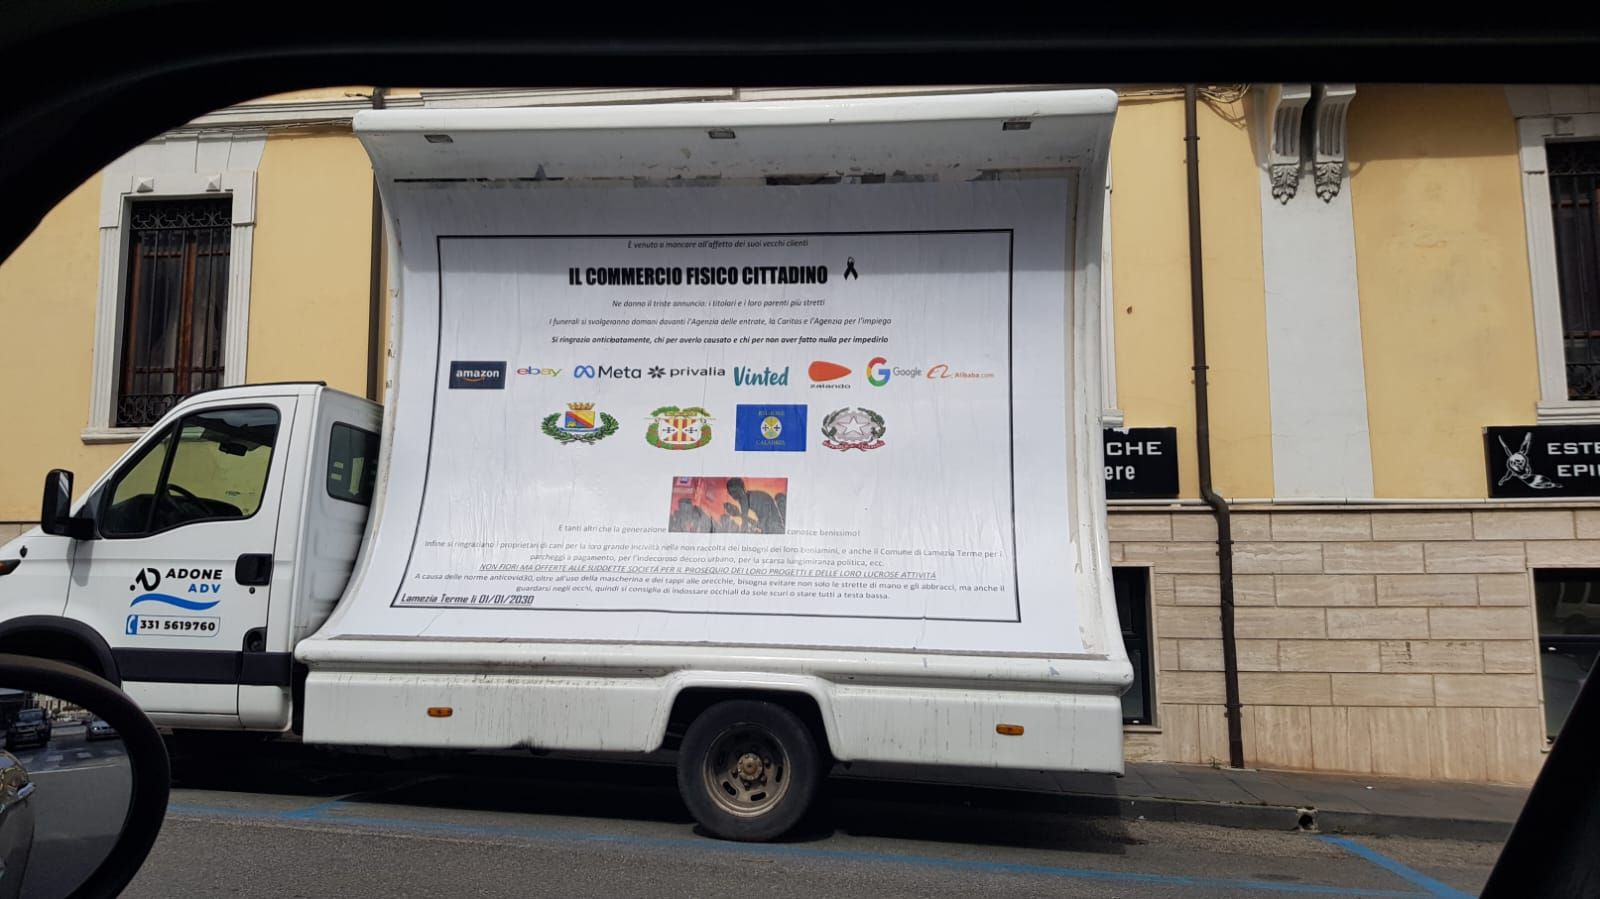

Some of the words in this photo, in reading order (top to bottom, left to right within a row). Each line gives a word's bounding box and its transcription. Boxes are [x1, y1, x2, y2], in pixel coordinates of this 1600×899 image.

[634, 240, 658, 249] venuto
[697, 239, 733, 250] all'affetto
[734, 239, 746, 248] dei
[747, 239, 762, 247] suoi
[763, 239, 785, 247] vecchi
[786, 239, 808, 247] clienti
[569, 268, 582, 286] IL
[586, 267, 682, 285] COMMERCIO
[687, 266, 738, 285] FISICO
[742, 265, 828, 284] CITTADINO
[623, 299, 646, 307] danno
[653, 299, 671, 307] triste
[712, 299, 737, 307] titolari
[763, 299, 789, 308] parenti
[790, 299, 801, 308] più
[803, 298, 825, 306] stretti
[552, 318, 579, 327] funerali
[588, 318, 630, 327] svolgeranno
[720, 317, 738, 325] delle
[739, 317, 767, 327] entrate,
[777, 317, 802, 325] Caritas
[844, 318, 856, 326] per
[559, 336, 591, 345] ringrazia
[665, 337, 678, 345] per
[751, 337, 764, 345] per
[798, 336, 817, 345] fatto
[838, 337, 852, 345] per
[853, 336, 889, 345] impedirlo
[456, 369, 500, 379] amazon
[517, 366, 563, 377] ebay
[599, 365, 642, 379] Meta
[670, 366, 725, 378] privalia
[734, 366, 789, 387] Vinted
[894, 366, 922, 378] Google
[1557, 464, 1600, 477] EPI
[583, 524, 598, 532] altri
[621, 525, 667, 535] generazione
[819, 529, 860, 537] benissimo!
[165, 568, 223, 580] ADONE
[535, 563, 567, 571] OFFERTE
[746, 567, 767, 575] LORO
[864, 570, 899, 578] LUCROSE
[188, 583, 221, 593] ADV
[489, 573, 534, 583] anticovid30,
[536, 574, 553, 582] oltre
[599, 575, 643, 583] mascherina
[651, 576, 663, 584] dei
[665, 576, 684, 586] tappi
[701, 577, 735, 587] orecchie,
[737, 578, 768, 588] bisogna
[769, 579, 796, 587] evitare
[814, 580, 830, 588] solo
[910, 583, 920, 592] gli
[921, 583, 957, 593] abbracci,
[973, 584, 998, 592] anche
[552, 584, 570, 594] negli
[572, 585, 593, 594] occhi,
[595, 585, 619, 595] quindi
[628, 586, 661, 595] consiglia
[818, 590, 835, 598] tutti
[401, 593, 437, 603] Lamezia
[440, 594, 468, 603] Terme
[479, 594, 534, 605] 01/01/2030
[140, 620, 159, 630] 331
[164, 621, 215, 631] 5619760
